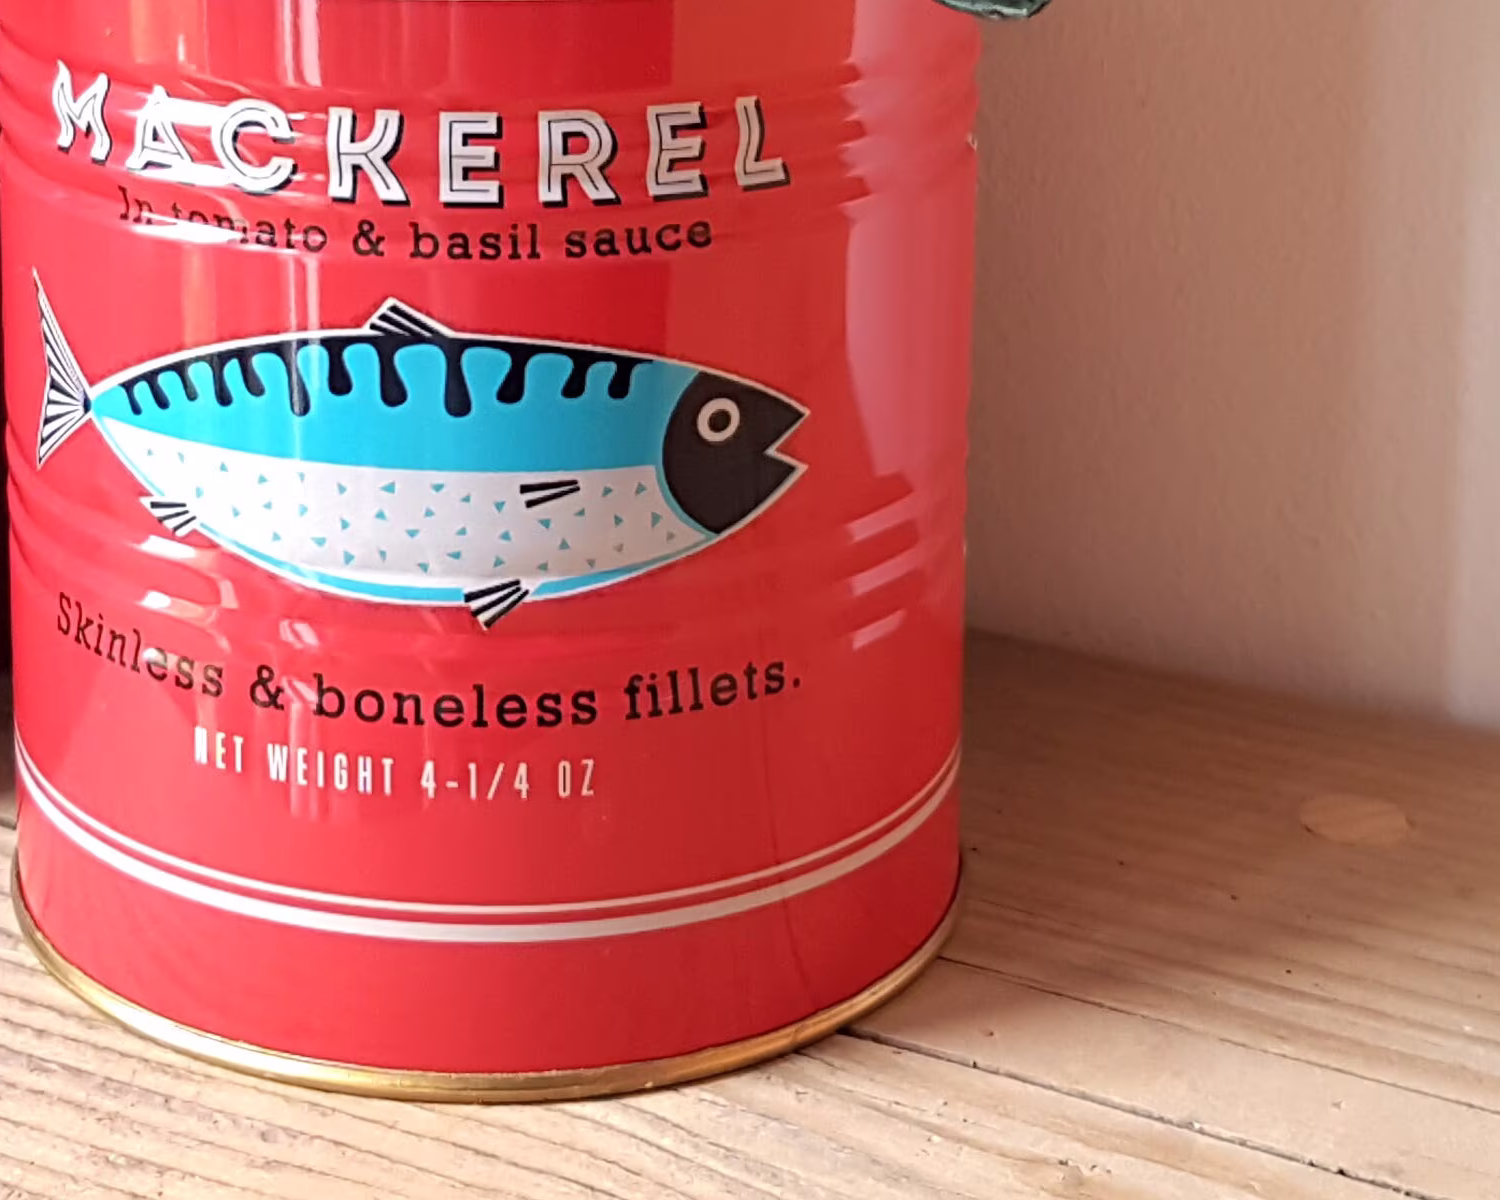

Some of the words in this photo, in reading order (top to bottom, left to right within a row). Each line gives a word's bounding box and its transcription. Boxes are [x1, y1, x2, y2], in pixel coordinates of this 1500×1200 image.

[51, 58, 790, 209] MACKEREL
[352, 219, 386, 257] &
[408, 221, 541, 260] basil
[564, 220, 713, 259] sauce
[56, 590, 224, 699] Skinless
[249, 663, 285, 711] &
[311, 671, 598, 729] boneless
[623, 660, 801, 721] fillets.
[193, 724, 244, 774] NET
[266, 742, 395, 797] WEIGHT
[420, 758, 530, 801] 4-1/4
[557, 757, 595, 799] OZ
